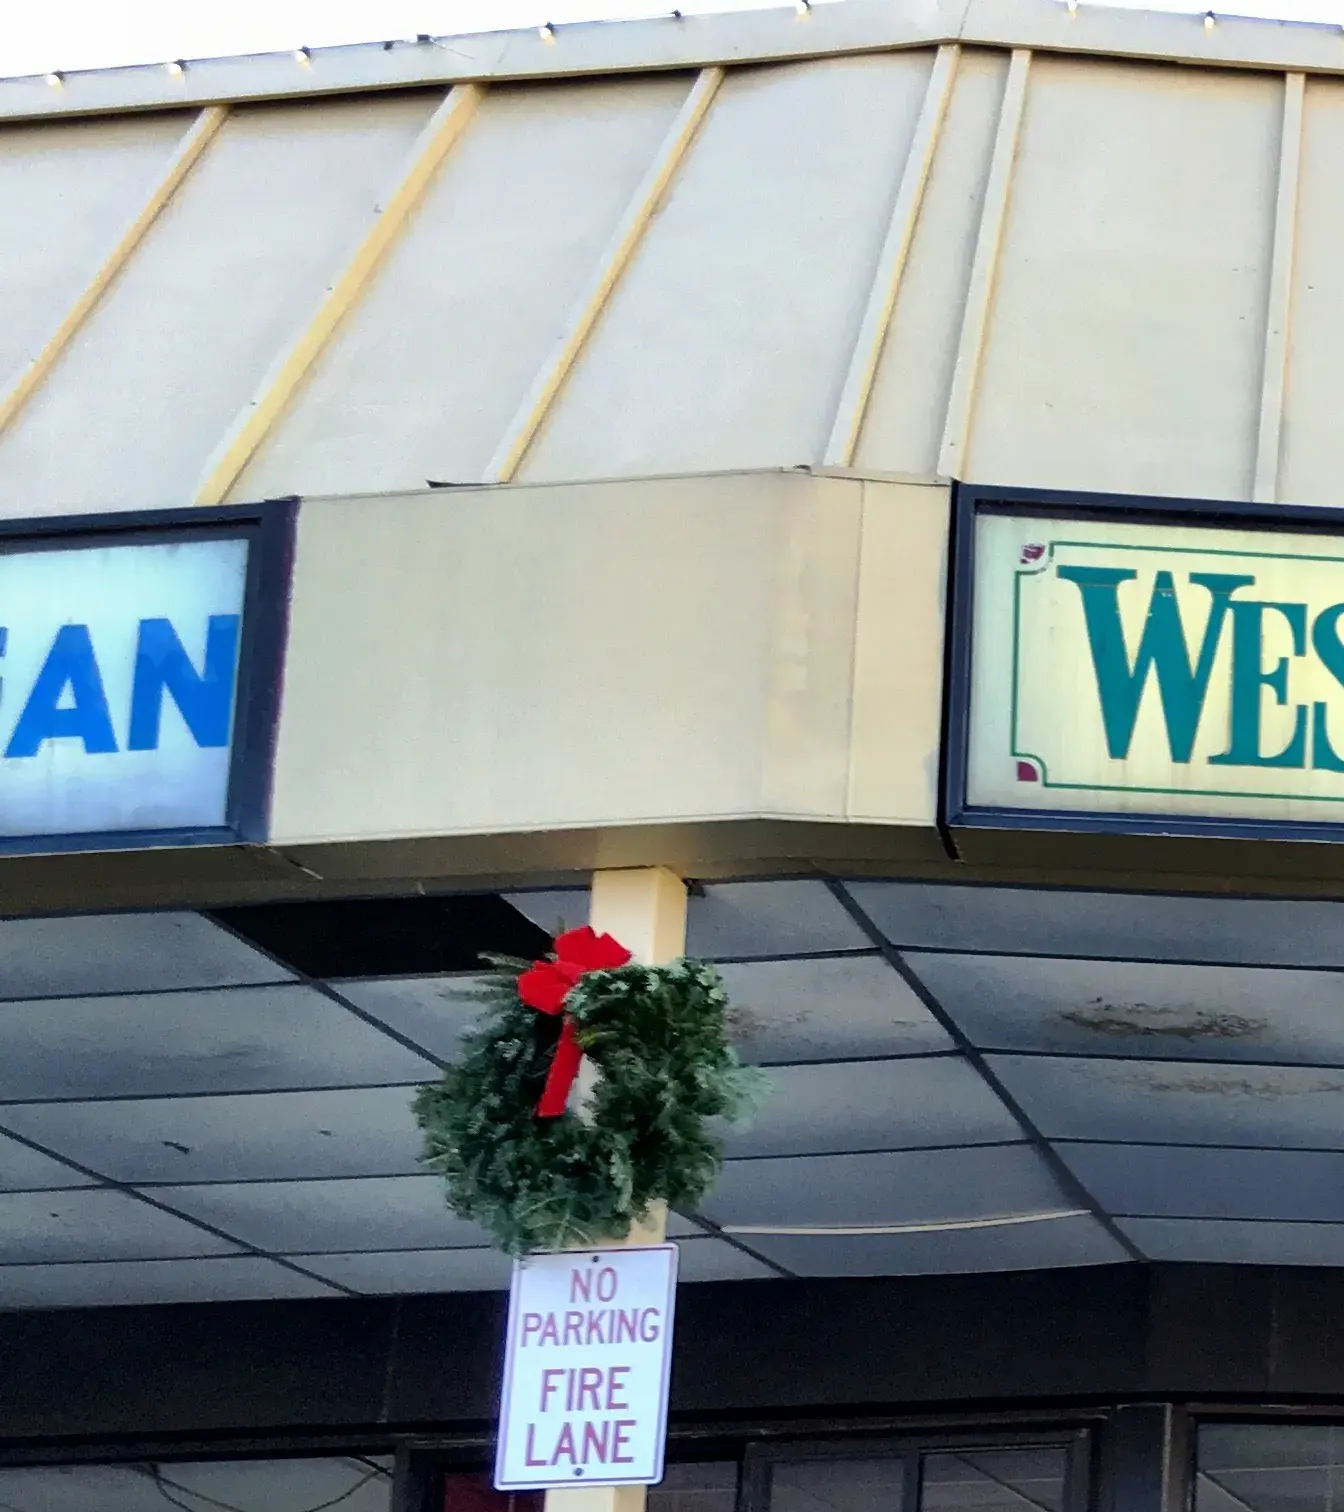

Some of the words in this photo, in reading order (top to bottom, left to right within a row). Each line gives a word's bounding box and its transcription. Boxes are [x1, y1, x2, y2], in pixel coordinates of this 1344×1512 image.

[0, 613, 241, 759] AN
[569, 1267, 618, 1304] NO
[520, 1307, 660, 1347] PARKING
[539, 1366, 631, 1412] FIRE
[524, 1420, 637, 1467] LANE
